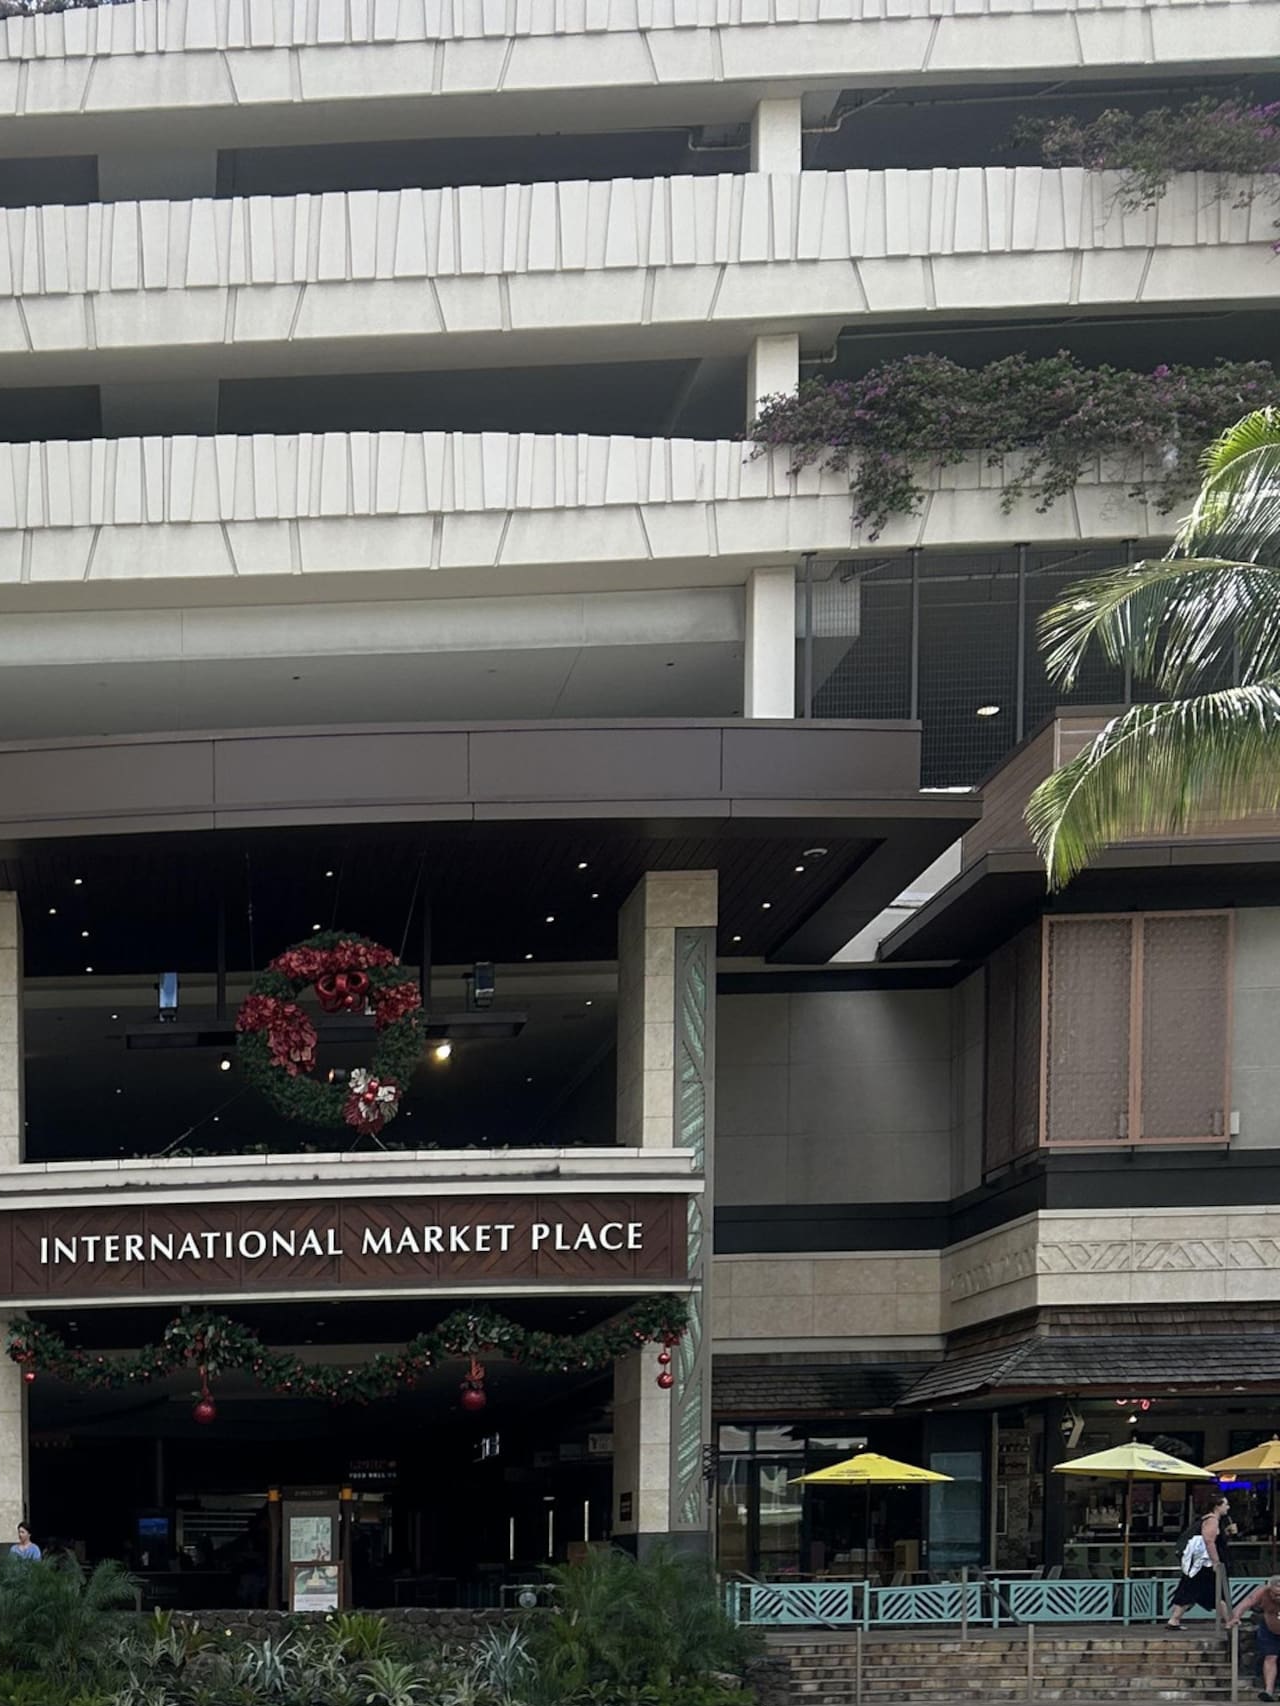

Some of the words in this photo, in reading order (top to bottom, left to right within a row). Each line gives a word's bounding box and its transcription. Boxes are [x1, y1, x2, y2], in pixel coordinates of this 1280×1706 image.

[39, 1228, 344, 1265] INTERNATIONAL
[361, 1224, 516, 1254] MARKET
[531, 1223, 644, 1251] PLACE
